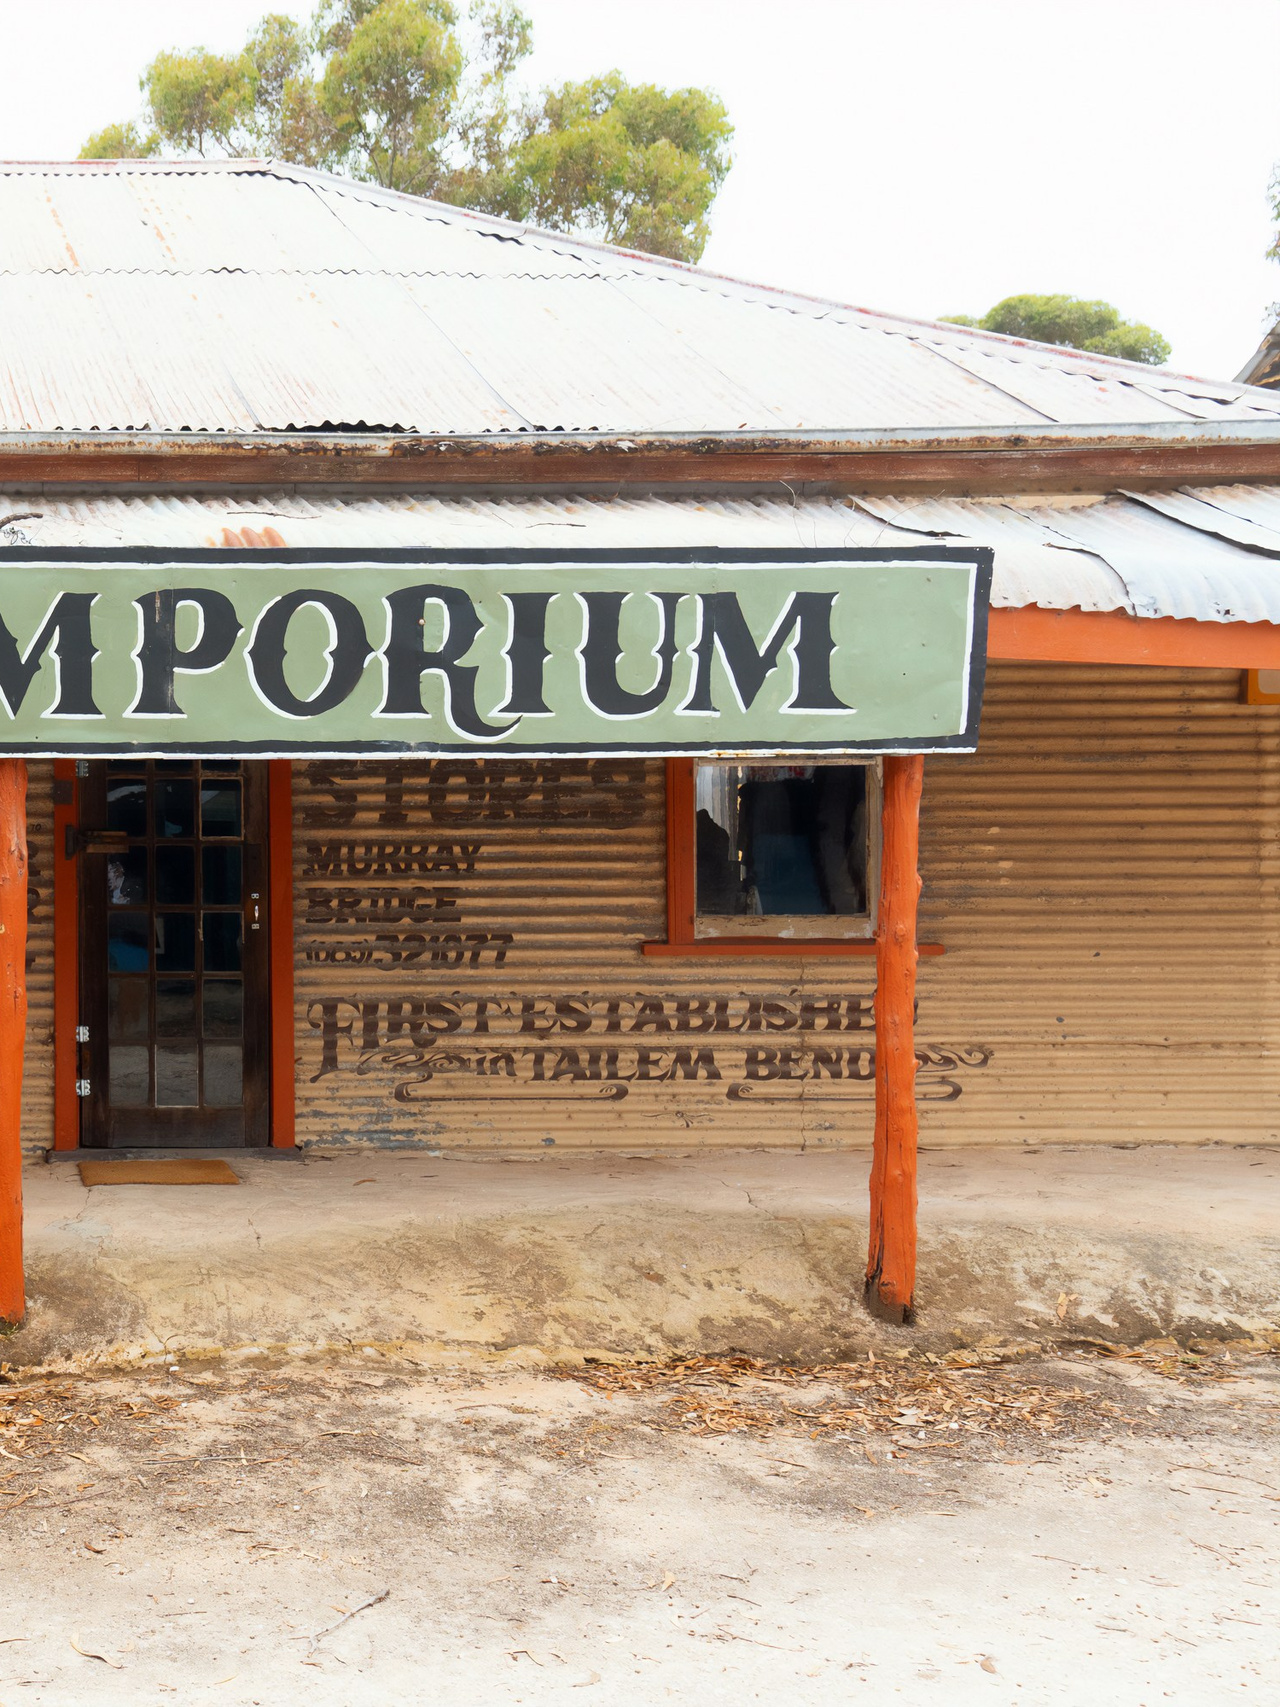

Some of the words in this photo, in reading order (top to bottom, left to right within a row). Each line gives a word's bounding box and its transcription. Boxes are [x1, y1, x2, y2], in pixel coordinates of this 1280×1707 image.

[302, 838, 483, 876] MURRAY
[305, 886, 462, 923] BRIDGE
[307, 991, 513, 1083] FIRST
[520, 991, 918, 1032] ESTABLISHE
[474, 1047, 518, 1077] in
[522, 1046, 723, 1082] TAILEM
[743, 1046, 877, 1081] BEND
